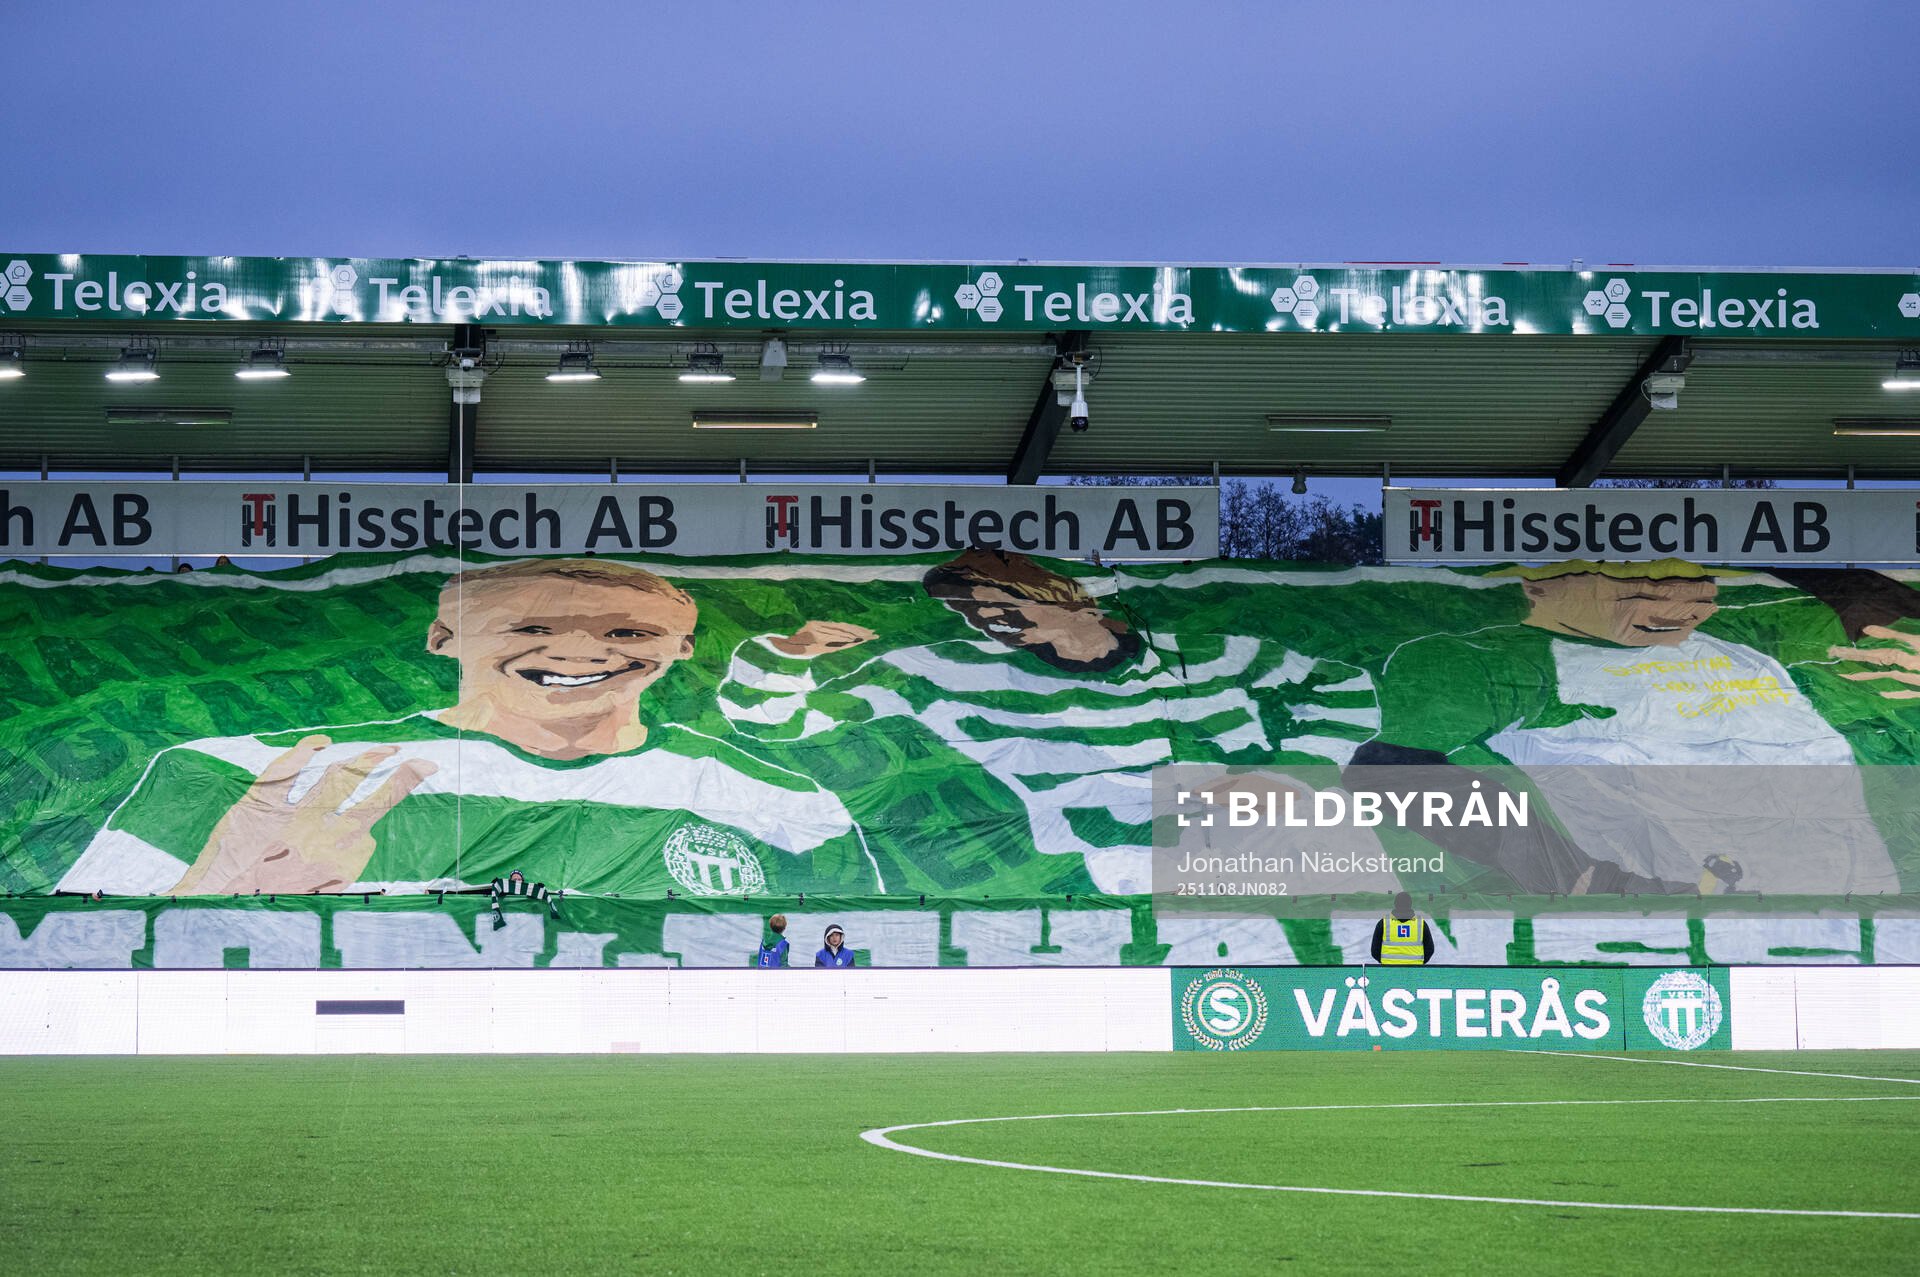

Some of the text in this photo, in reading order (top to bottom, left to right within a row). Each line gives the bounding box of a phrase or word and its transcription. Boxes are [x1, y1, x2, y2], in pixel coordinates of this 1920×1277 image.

[44, 271, 229, 313] Telexia
[368, 276, 553, 318] Telexia
[694, 279, 877, 321] Telexia
[1014, 282, 1195, 325] Telexia
[1329, 286, 1509, 327] Telexia
[1641, 288, 1819, 329] Telexia
[58, 493, 152, 547] AB
[287, 493, 561, 549] Hisstech
[586, 496, 677, 548] AB
[811, 494, 1080, 551] Hisstech
[1103, 499, 1194, 551] AB
[1453, 497, 1718, 553] Hisstech
[1742, 502, 1831, 553] AB
[1293, 976, 1611, 1040] VÄSTERÅS
